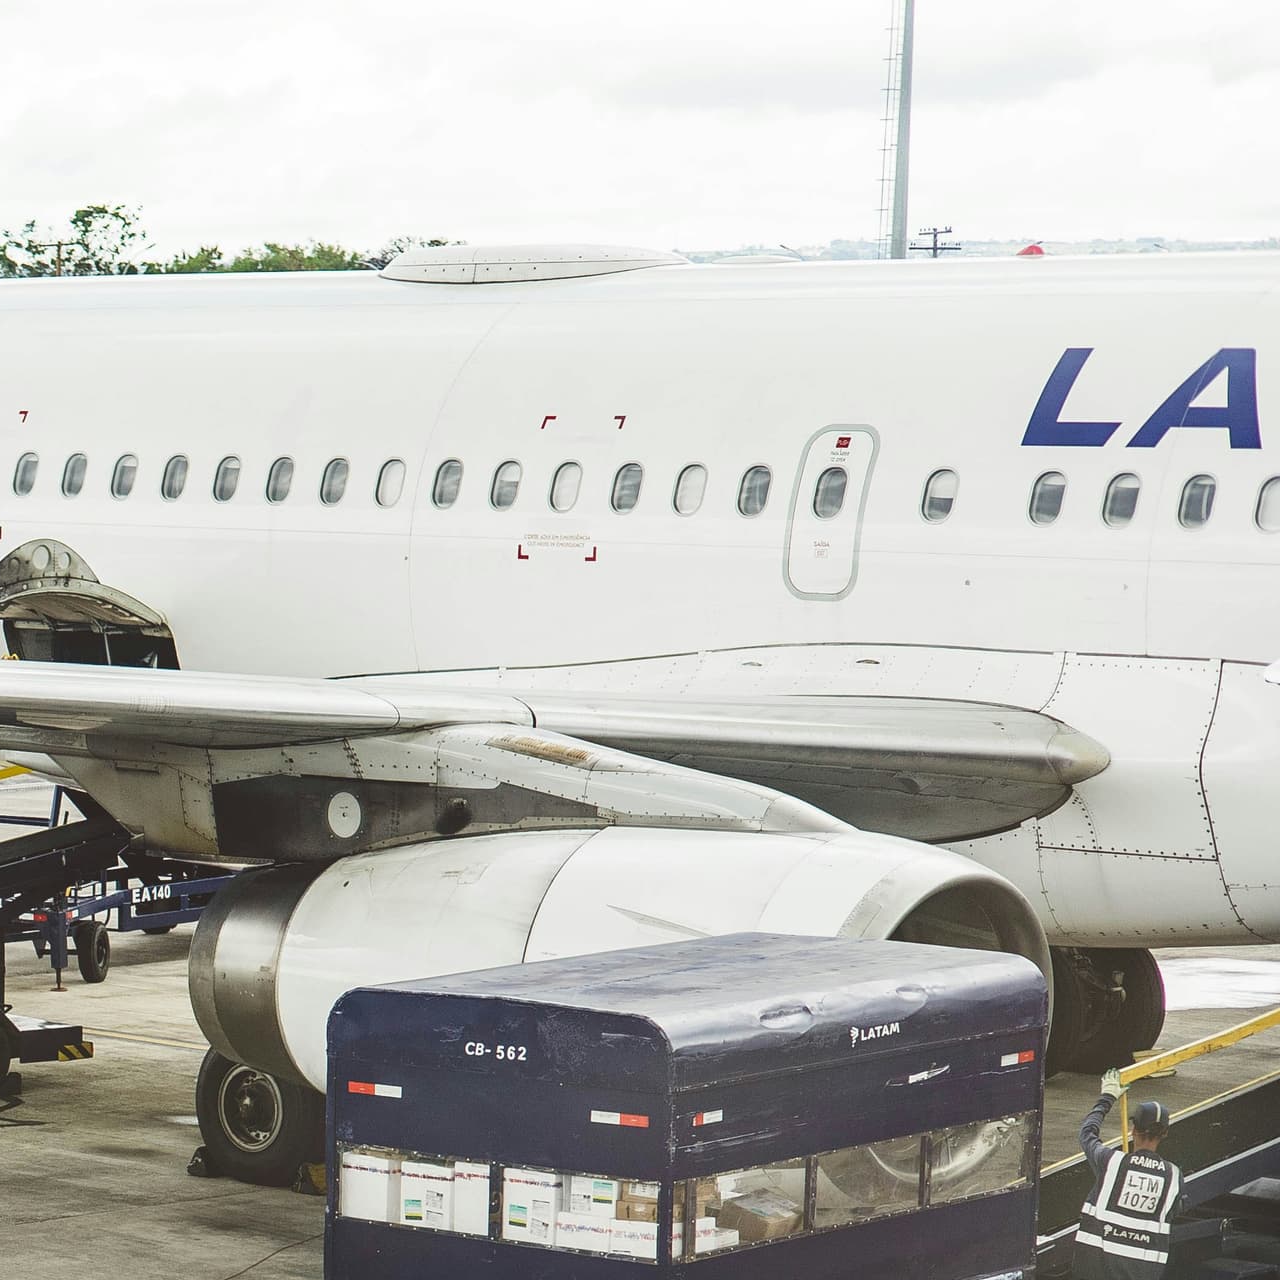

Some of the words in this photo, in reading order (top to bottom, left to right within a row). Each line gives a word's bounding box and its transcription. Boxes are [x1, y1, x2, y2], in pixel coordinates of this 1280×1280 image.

[1021, 347, 1262, 450] LA
[860, 1022, 900, 1041] LATAM
[1130, 1155, 1165, 1171] RAMPA
[1128, 1175, 1159, 1194] LTM
[1123, 1191, 1157, 1211] 1073
[1113, 1228, 1151, 1244] LATAM
